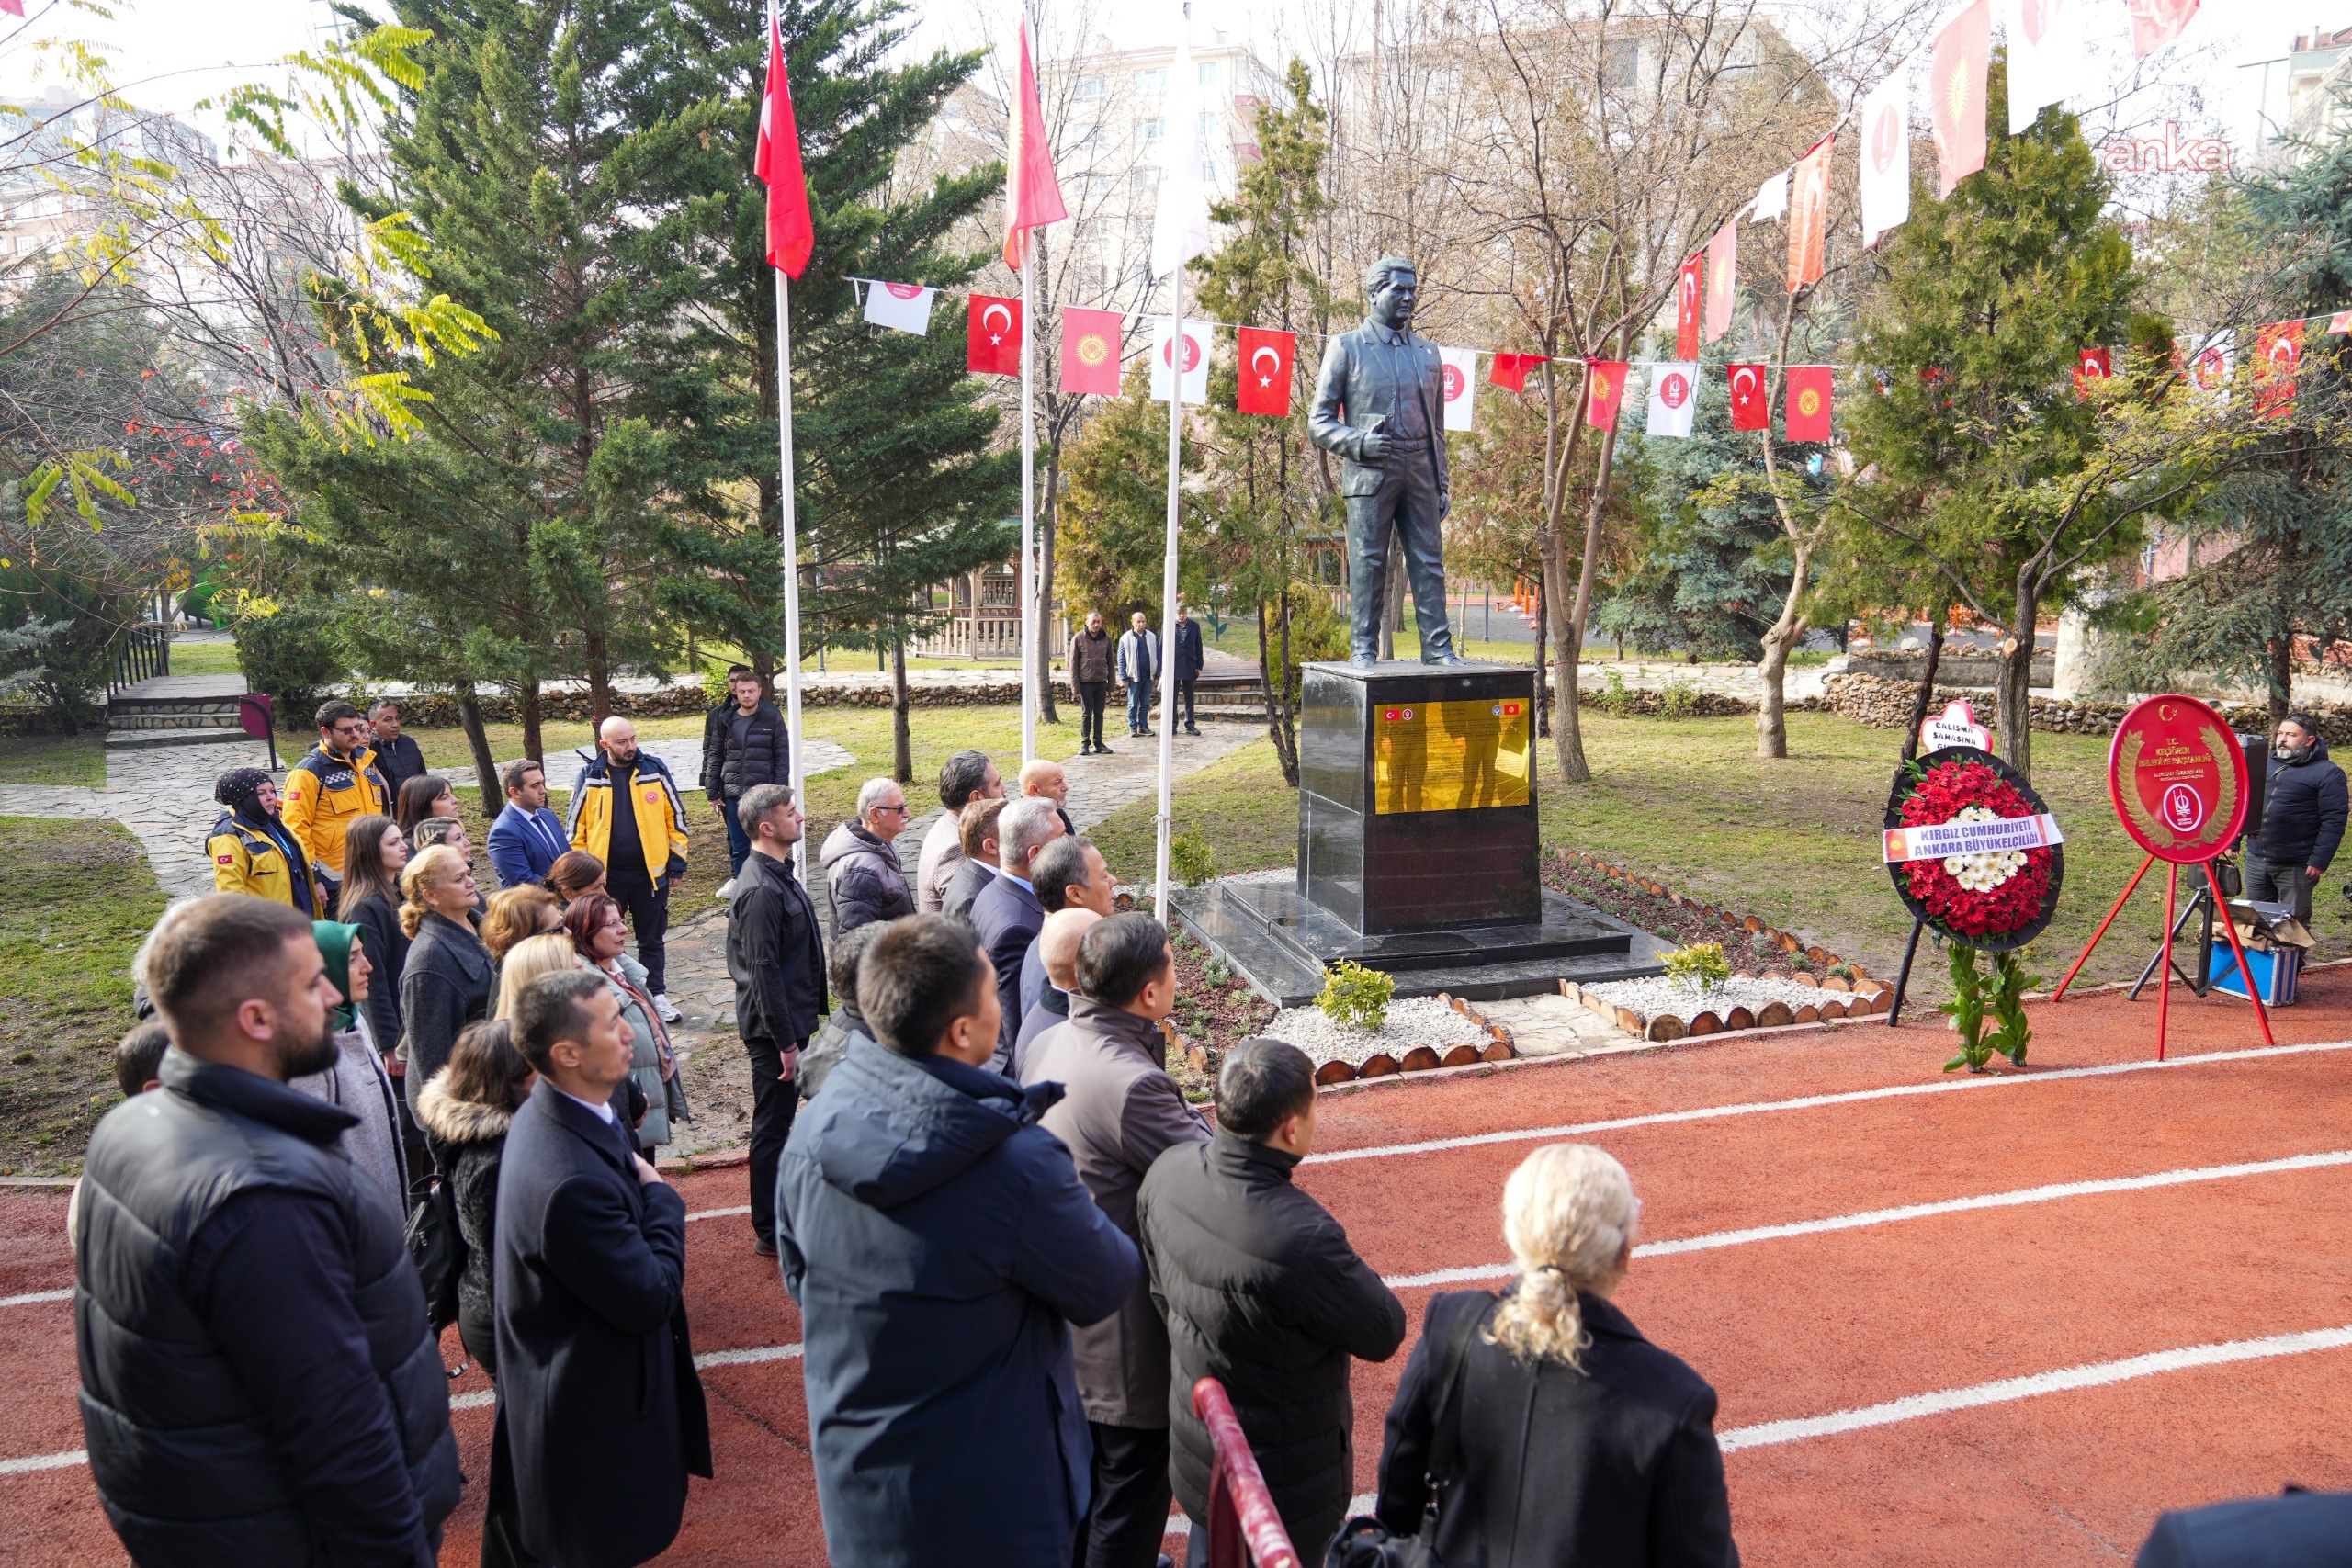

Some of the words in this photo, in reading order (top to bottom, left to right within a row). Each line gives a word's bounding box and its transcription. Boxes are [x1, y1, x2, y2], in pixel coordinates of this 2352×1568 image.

[1932, 731, 1976, 745] SAHASINA
[2155, 746, 2189, 756] KEÇİÖREN
[1921, 828, 1959, 841] KIRGIZ
[1962, 820, 2031, 838] CUMHURİYETİ
[1915, 842, 1963, 856] ANKARA
[1965, 833, 2039, 852] BÜYÜKELÇİLİĞİ
